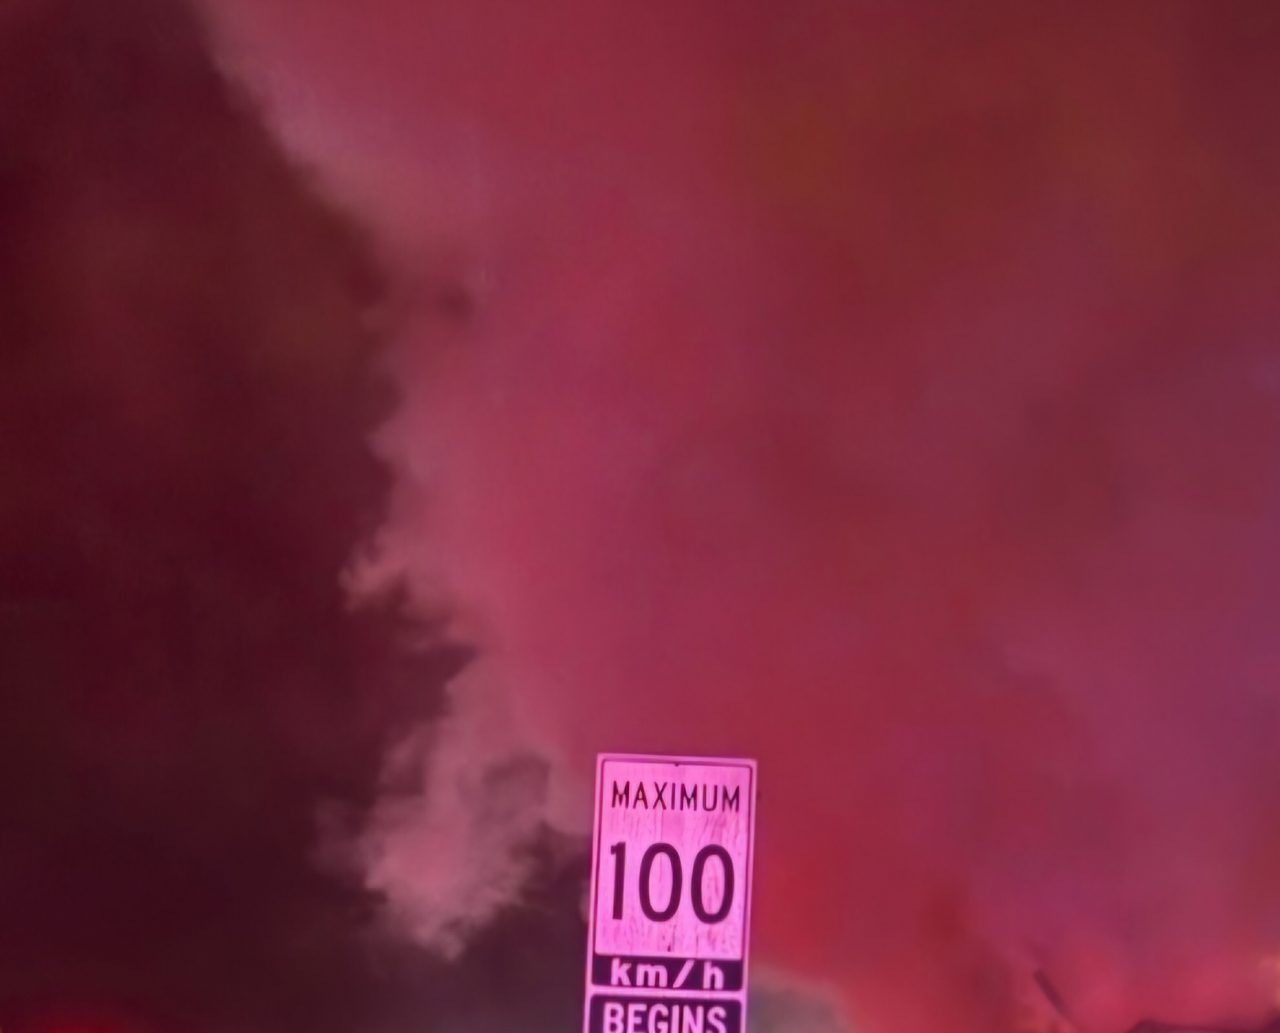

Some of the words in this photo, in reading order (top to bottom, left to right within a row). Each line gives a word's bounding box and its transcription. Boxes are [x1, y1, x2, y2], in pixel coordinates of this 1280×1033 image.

[610, 780, 741, 813] MAXIMUM
[610, 841, 735, 924] 100
[610, 958, 725, 989] km/h
